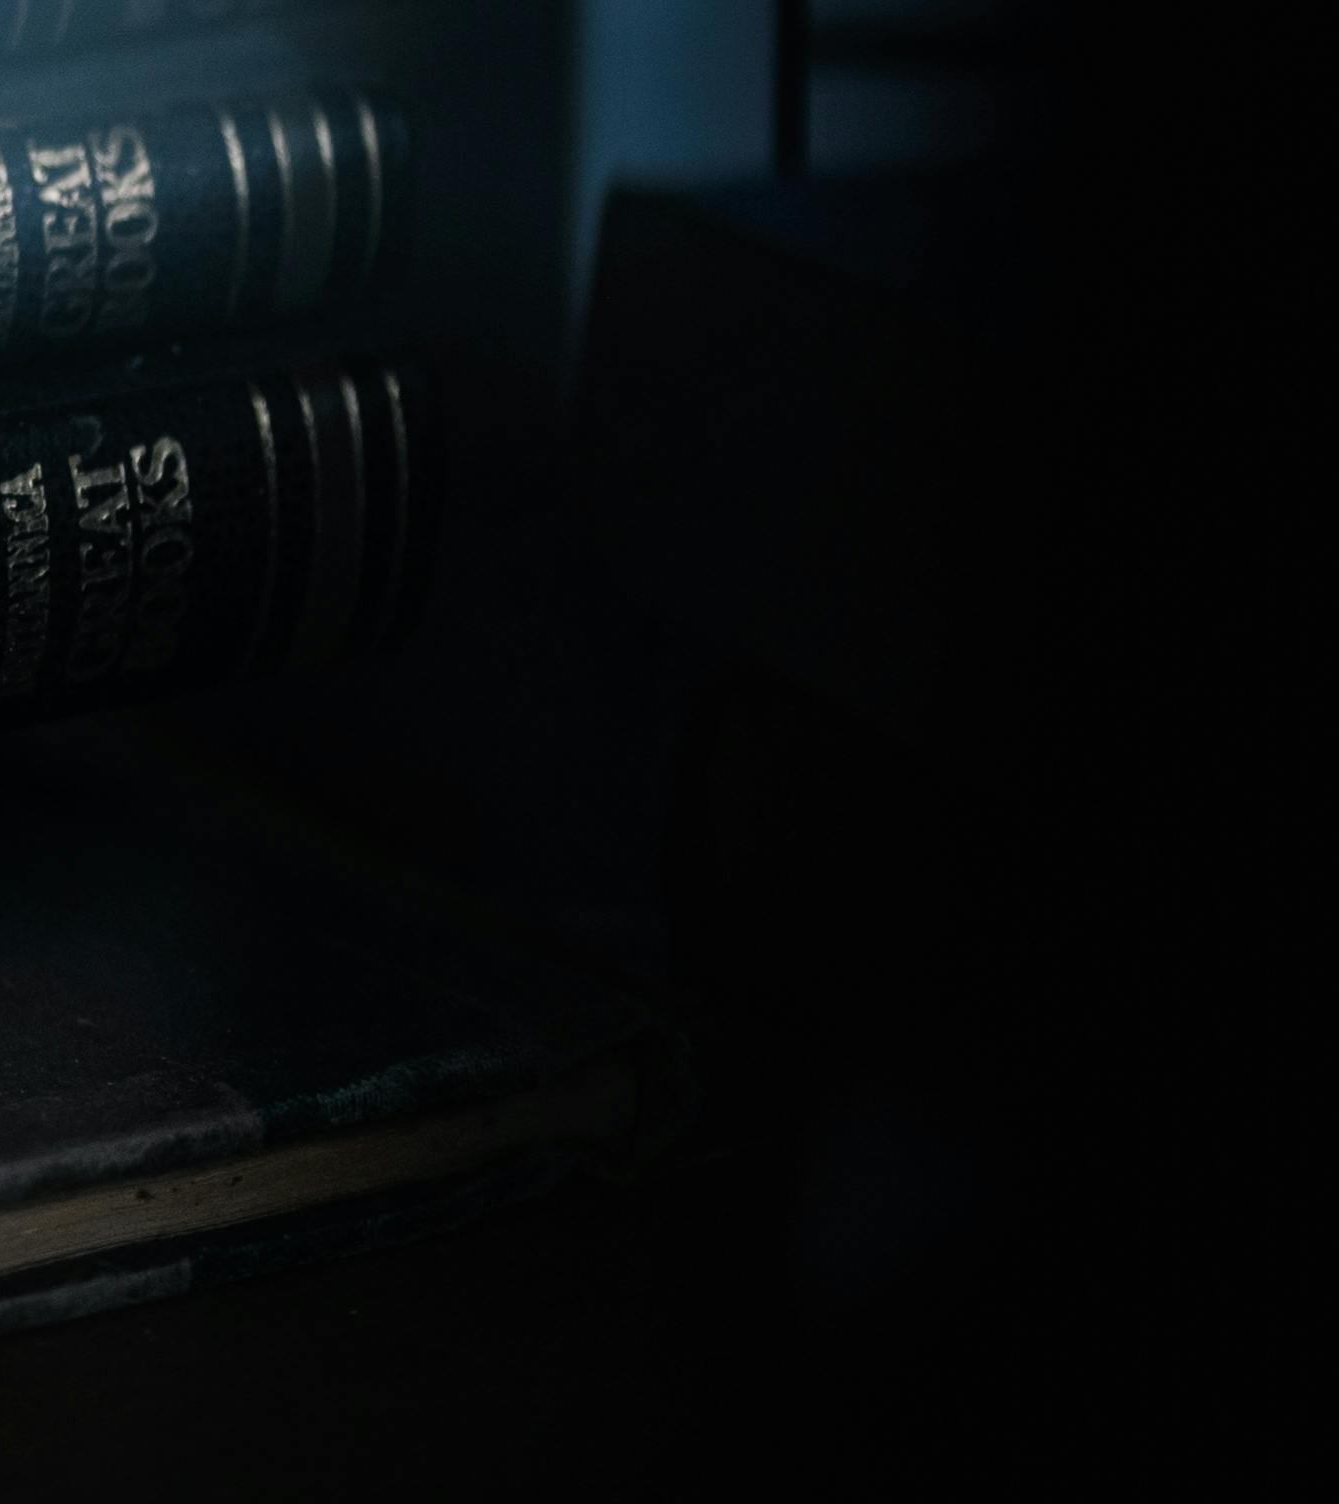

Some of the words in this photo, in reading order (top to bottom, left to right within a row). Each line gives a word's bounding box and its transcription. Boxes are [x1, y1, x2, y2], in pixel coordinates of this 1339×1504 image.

[25, 138, 99, 336] GREAT
[89, 123, 160, 324] BOOKS
[67, 452, 134, 684] GREAT
[126, 434, 196, 671] BOOKS
